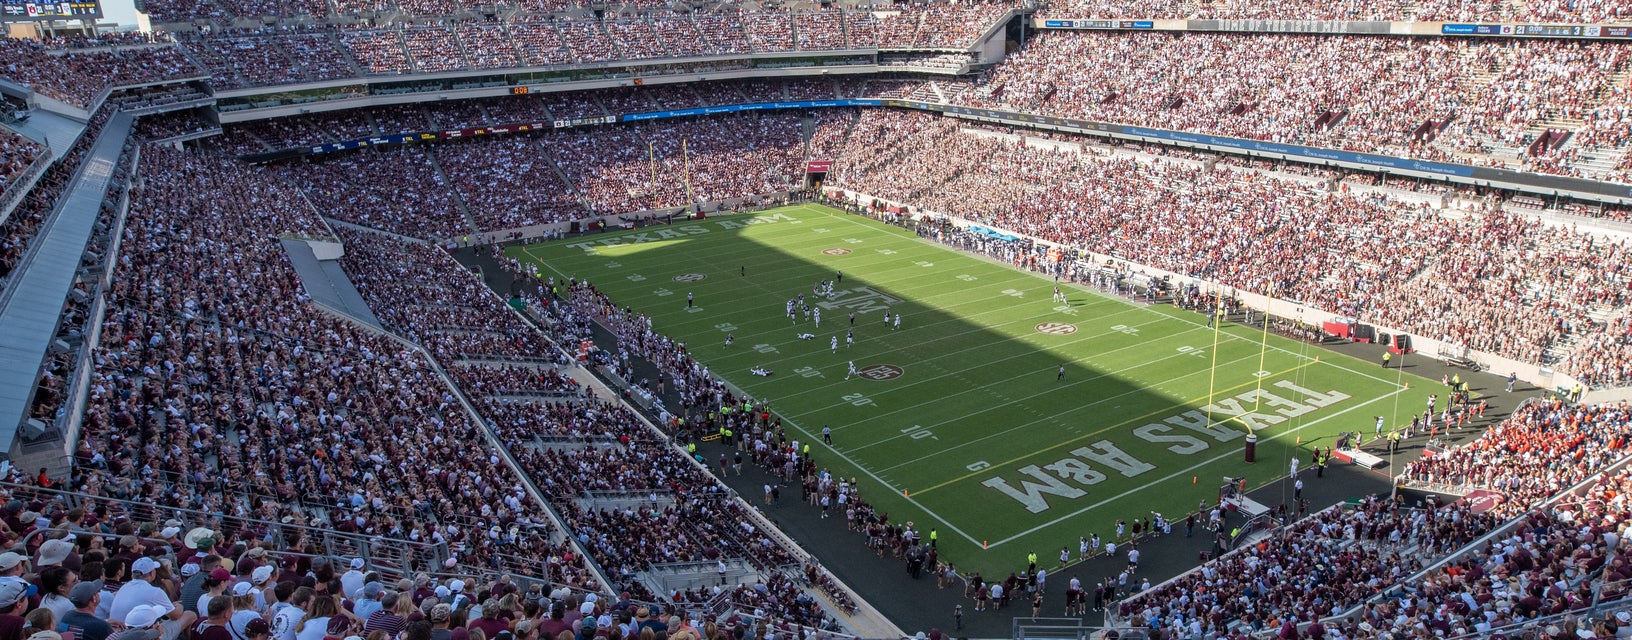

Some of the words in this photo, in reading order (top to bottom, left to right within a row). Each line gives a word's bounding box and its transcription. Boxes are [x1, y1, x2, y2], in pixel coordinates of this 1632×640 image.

[1218, 20, 1245, 32] HOME
[1265, 20, 1286, 32] THE
[1323, 21, 1348, 33] MAN
[1516, 25, 1525, 34] 21
[1574, 26, 1581, 35] 3
[566, 225, 711, 253] TEXAS
[715, 213, 798, 230] A&M
[1035, 322, 1076, 335] SEC
[793, 366, 822, 378] 30
[841, 393, 873, 406] 20
[1132, 380, 1353, 455] TEXAS
[900, 424, 932, 440] 10
[966, 460, 991, 472] G
[981, 440, 1158, 515] A&M
